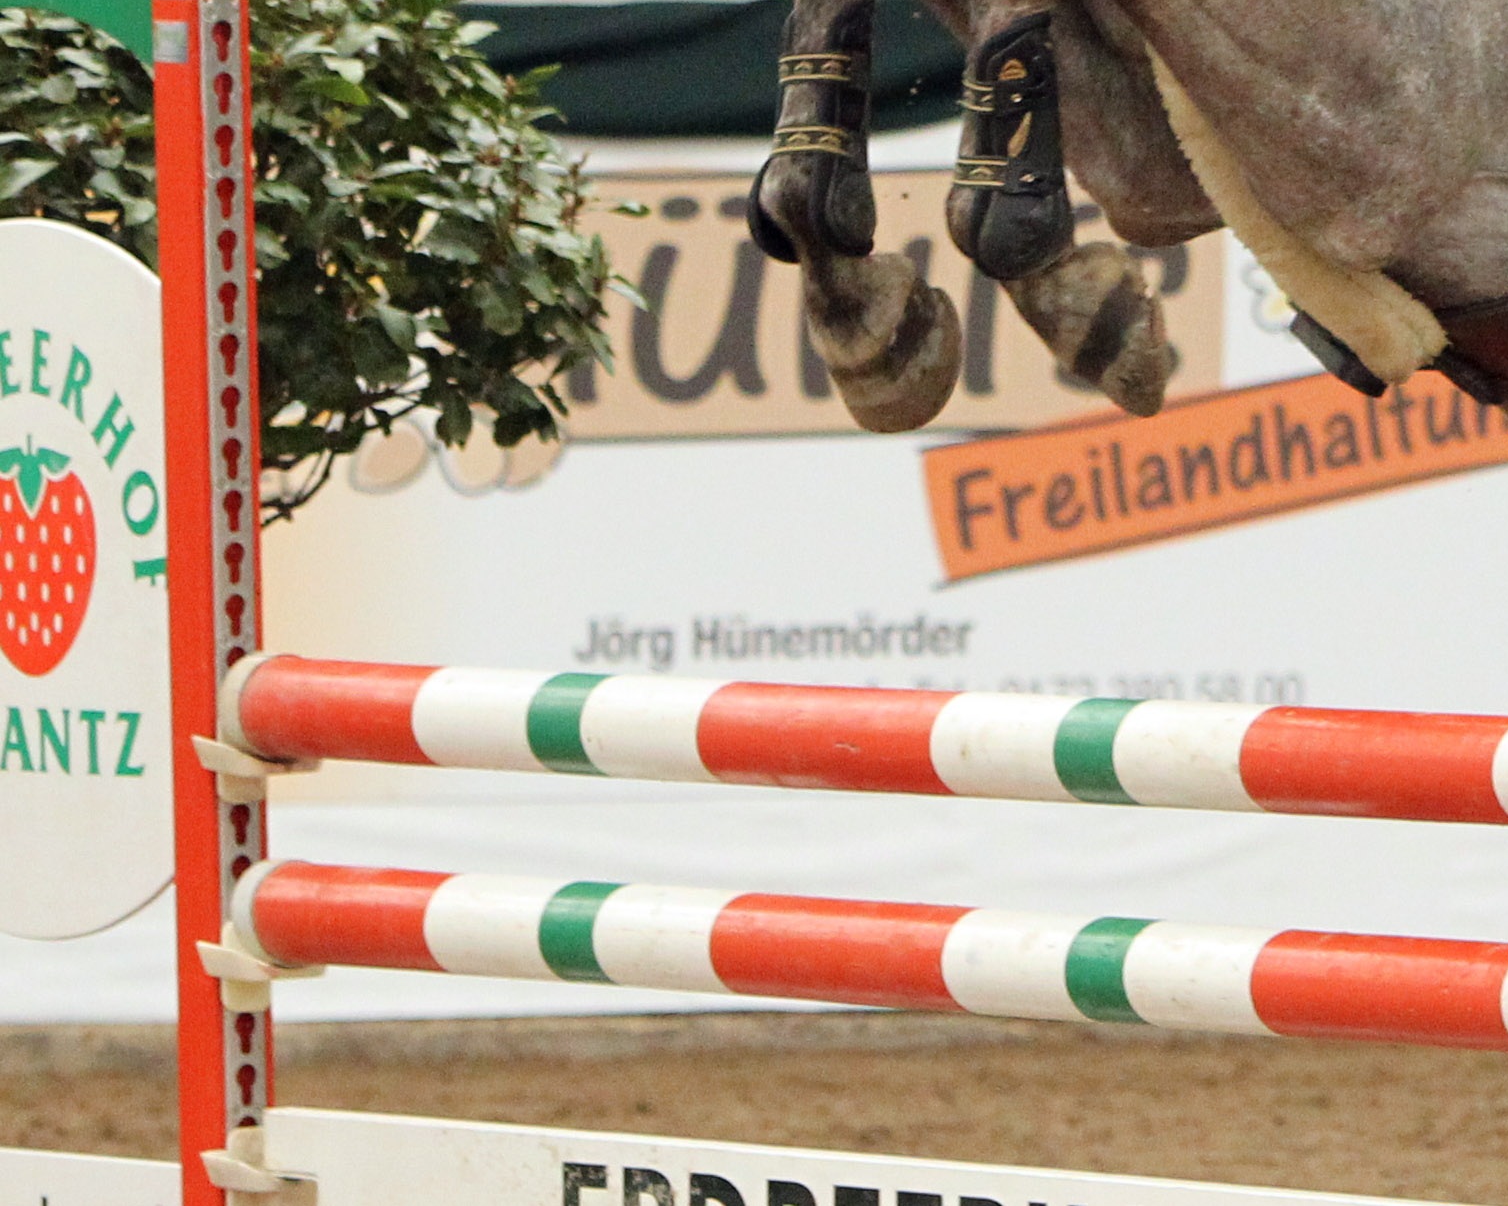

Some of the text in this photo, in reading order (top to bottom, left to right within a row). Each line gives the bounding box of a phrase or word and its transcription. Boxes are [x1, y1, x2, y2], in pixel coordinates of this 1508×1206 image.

[575, 613, 973, 672] Jörg Hünemörder
[0, 705, 146, 778] ANTZ
